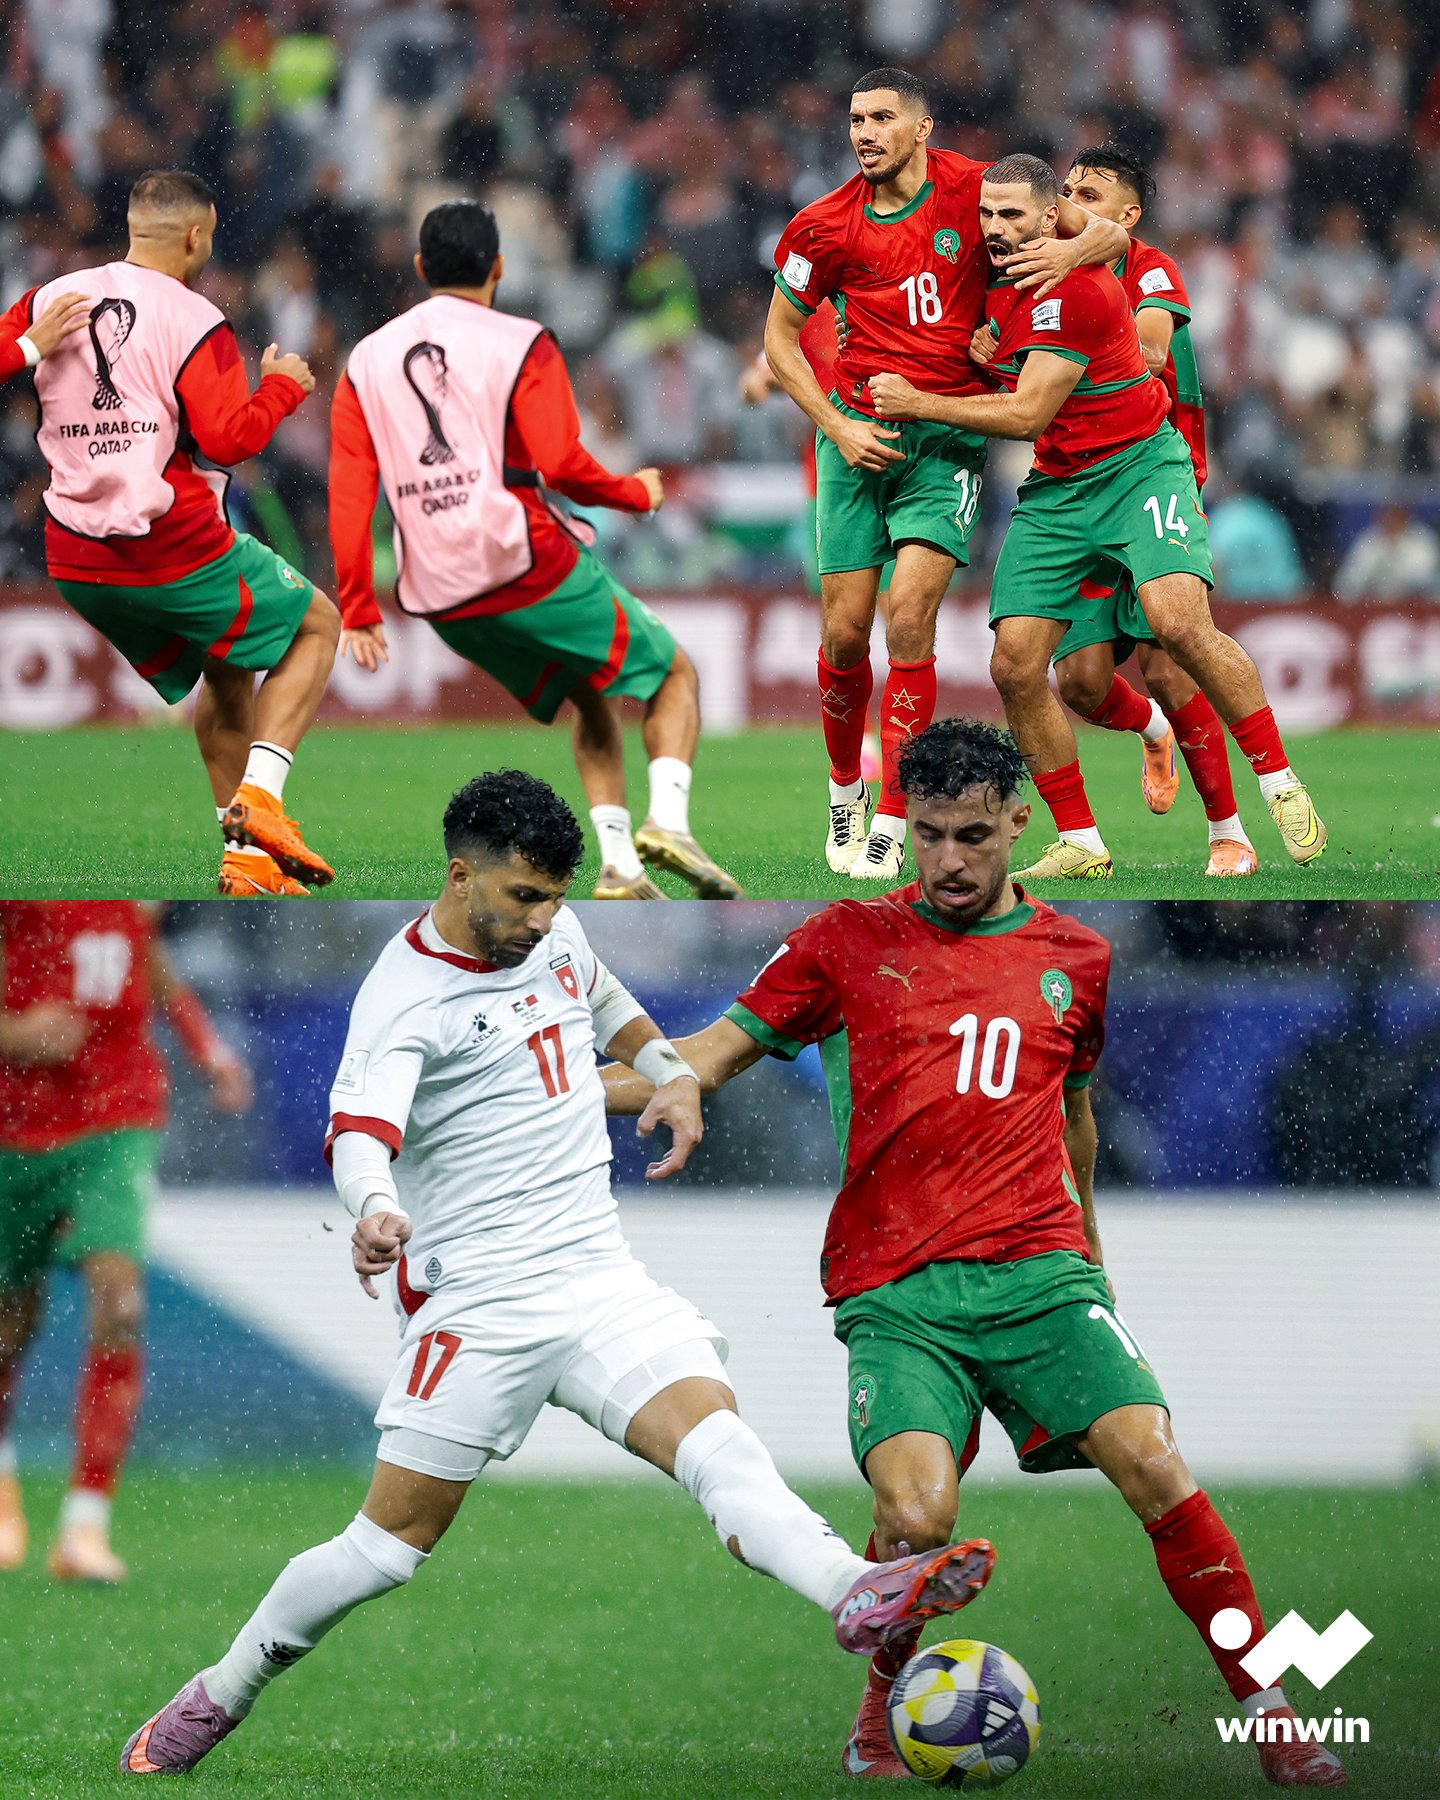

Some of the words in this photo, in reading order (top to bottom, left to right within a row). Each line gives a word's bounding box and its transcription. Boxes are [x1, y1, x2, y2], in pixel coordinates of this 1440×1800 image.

[898, 271, 943, 326] 18
[60, 423, 90, 439] FIFA
[94, 420, 129, 436] ARAB
[131, 420, 160, 434] CUP
[88, 440, 132, 460] QATAR
[953, 468, 983, 526] 18
[1143, 493, 1190, 539] 14
[472, 1024, 502, 1045] KELME
[526, 1023, 571, 1099] 17
[948, 1012, 1021, 1099] 10
[406, 1330, 463, 1401] 17
